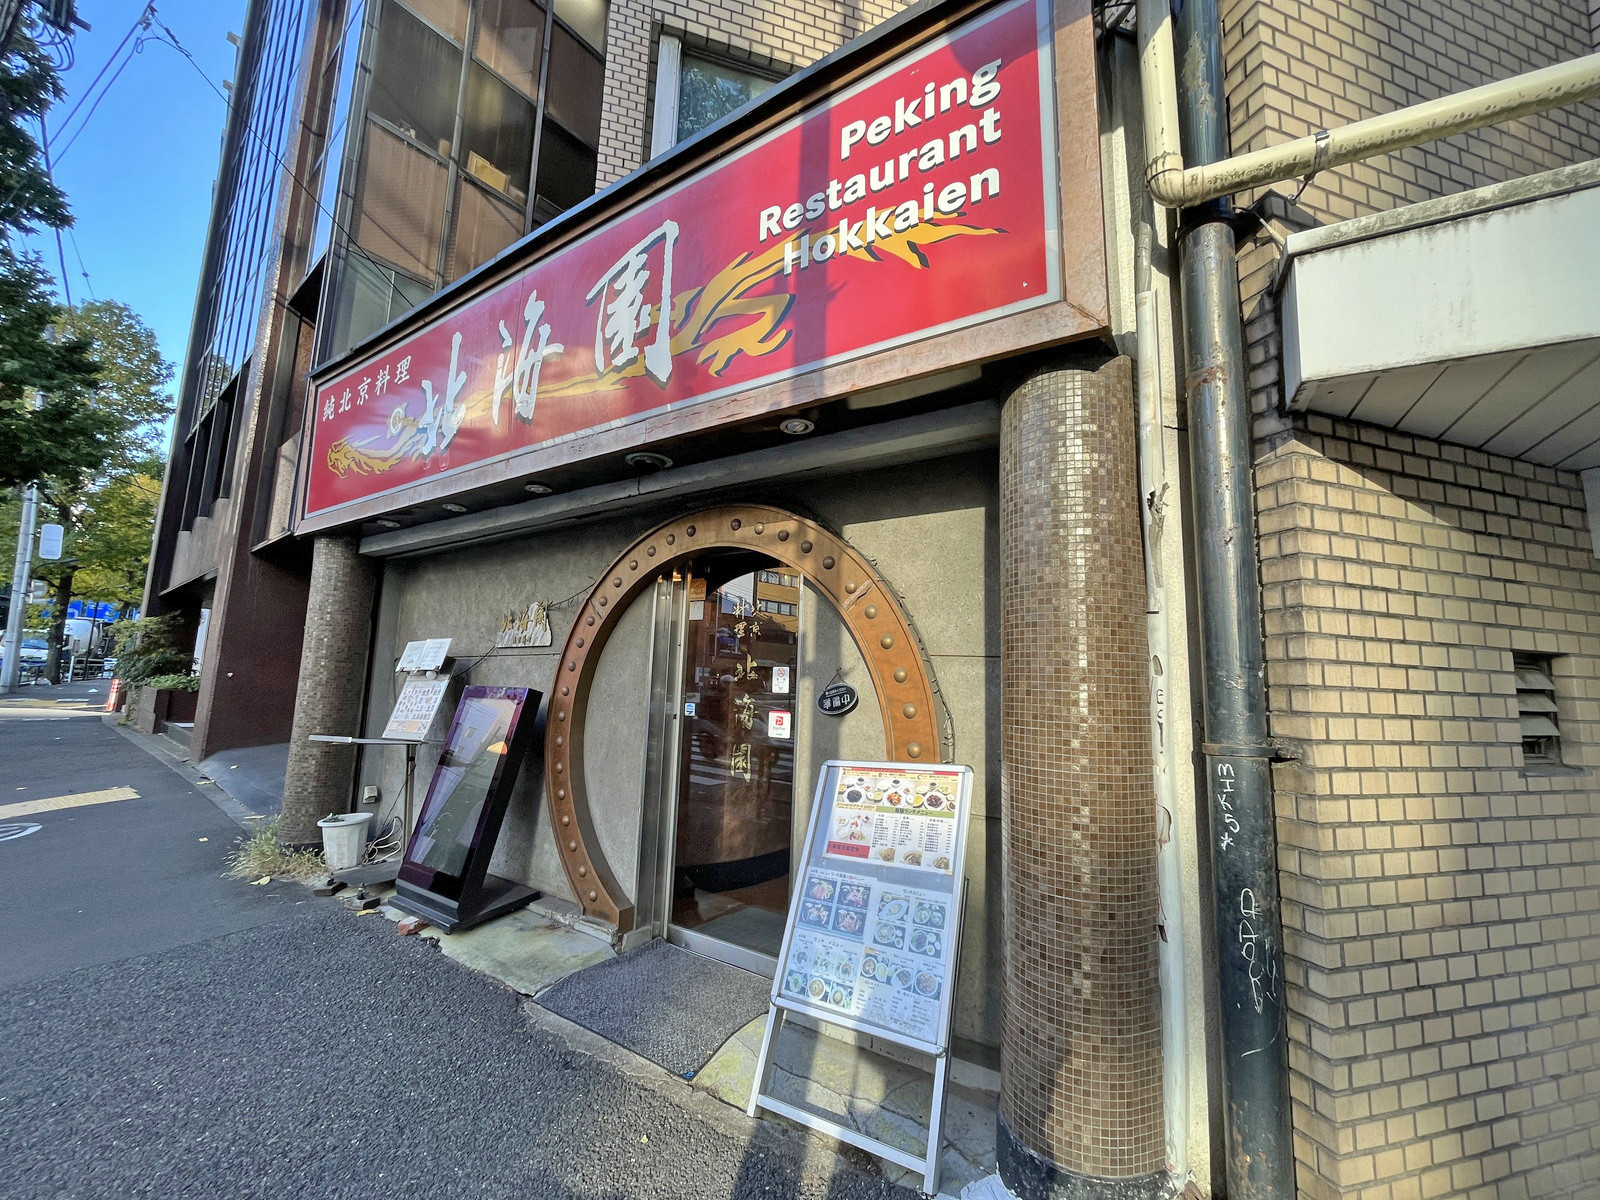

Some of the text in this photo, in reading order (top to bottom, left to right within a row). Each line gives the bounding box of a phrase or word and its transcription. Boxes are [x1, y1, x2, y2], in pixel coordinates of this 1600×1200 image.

[840, 58, 1002, 161] Peking
[759, 109, 1002, 242] Restaurant
[783, 167, 1000, 276] Hokkaien
[322, 355, 412, 422] 純北京料理
[822, 693, 850, 710] 準備中
